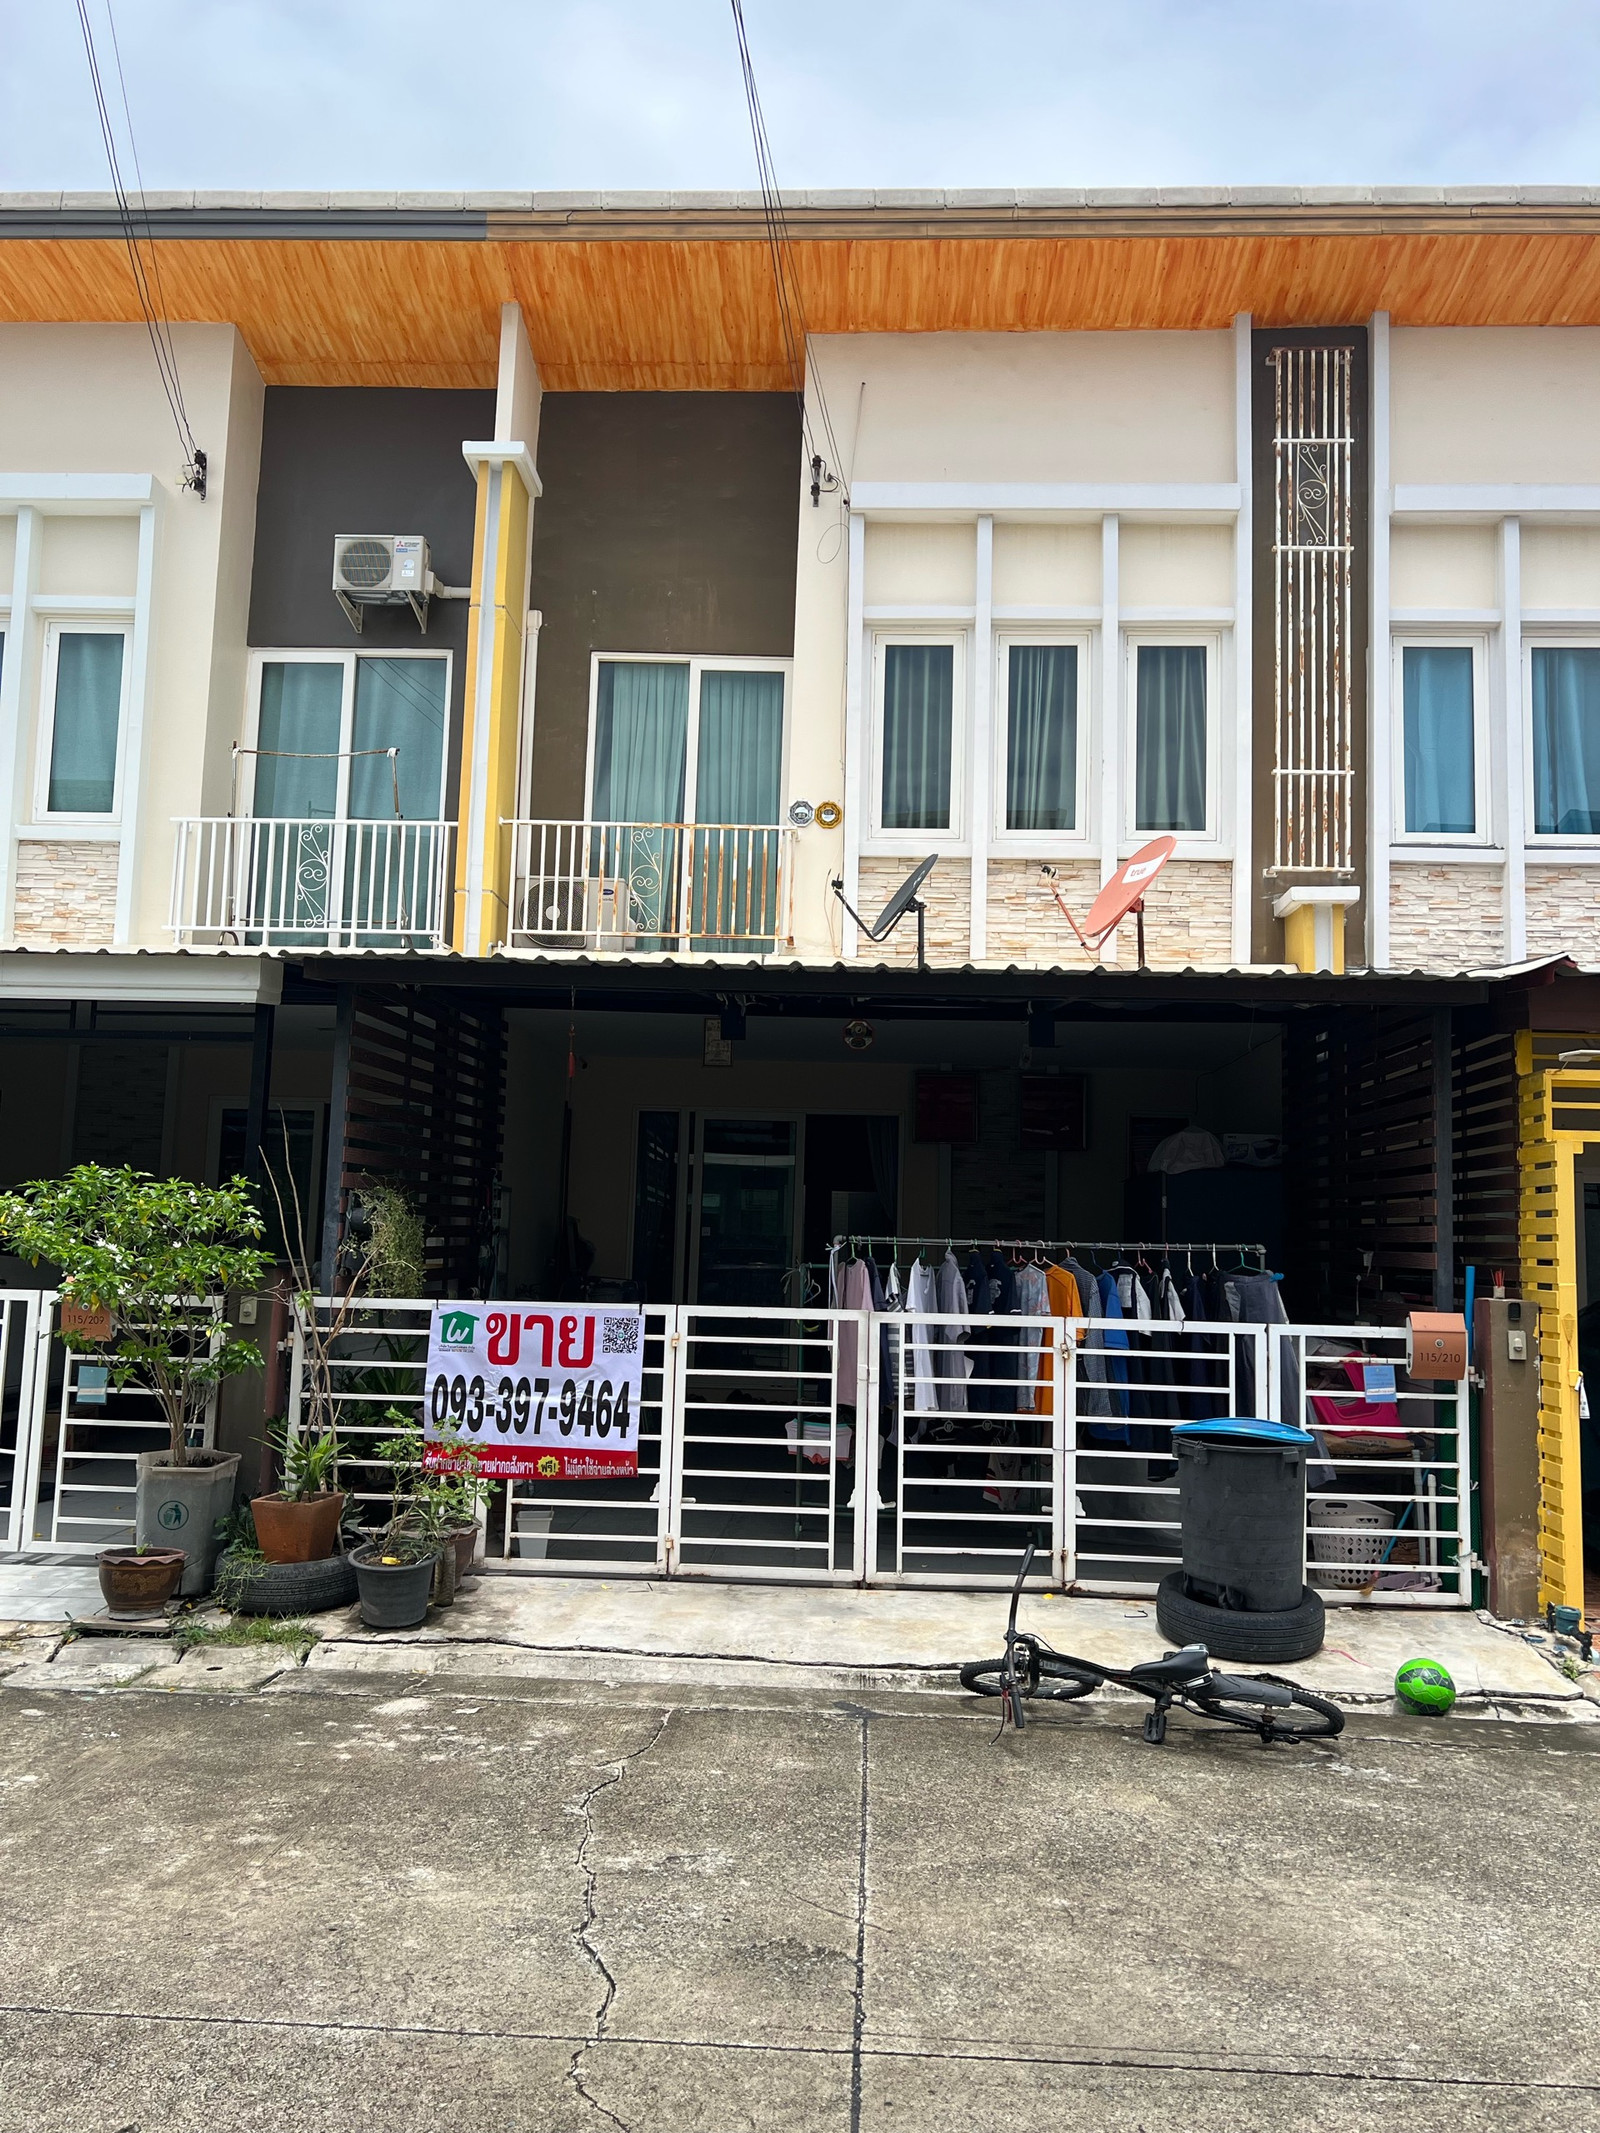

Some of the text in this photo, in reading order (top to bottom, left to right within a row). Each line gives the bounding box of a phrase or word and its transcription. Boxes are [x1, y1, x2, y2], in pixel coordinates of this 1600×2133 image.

[1130, 867, 1147, 877] true
[67, 1314, 105, 1325] 115/209
[485, 1312, 596, 1369] ขาย
[1419, 1352, 1461, 1364] 115/210
[431, 1373, 631, 1439] 093-397-9464
[540, 1460, 556, 1473] ฟรี!
